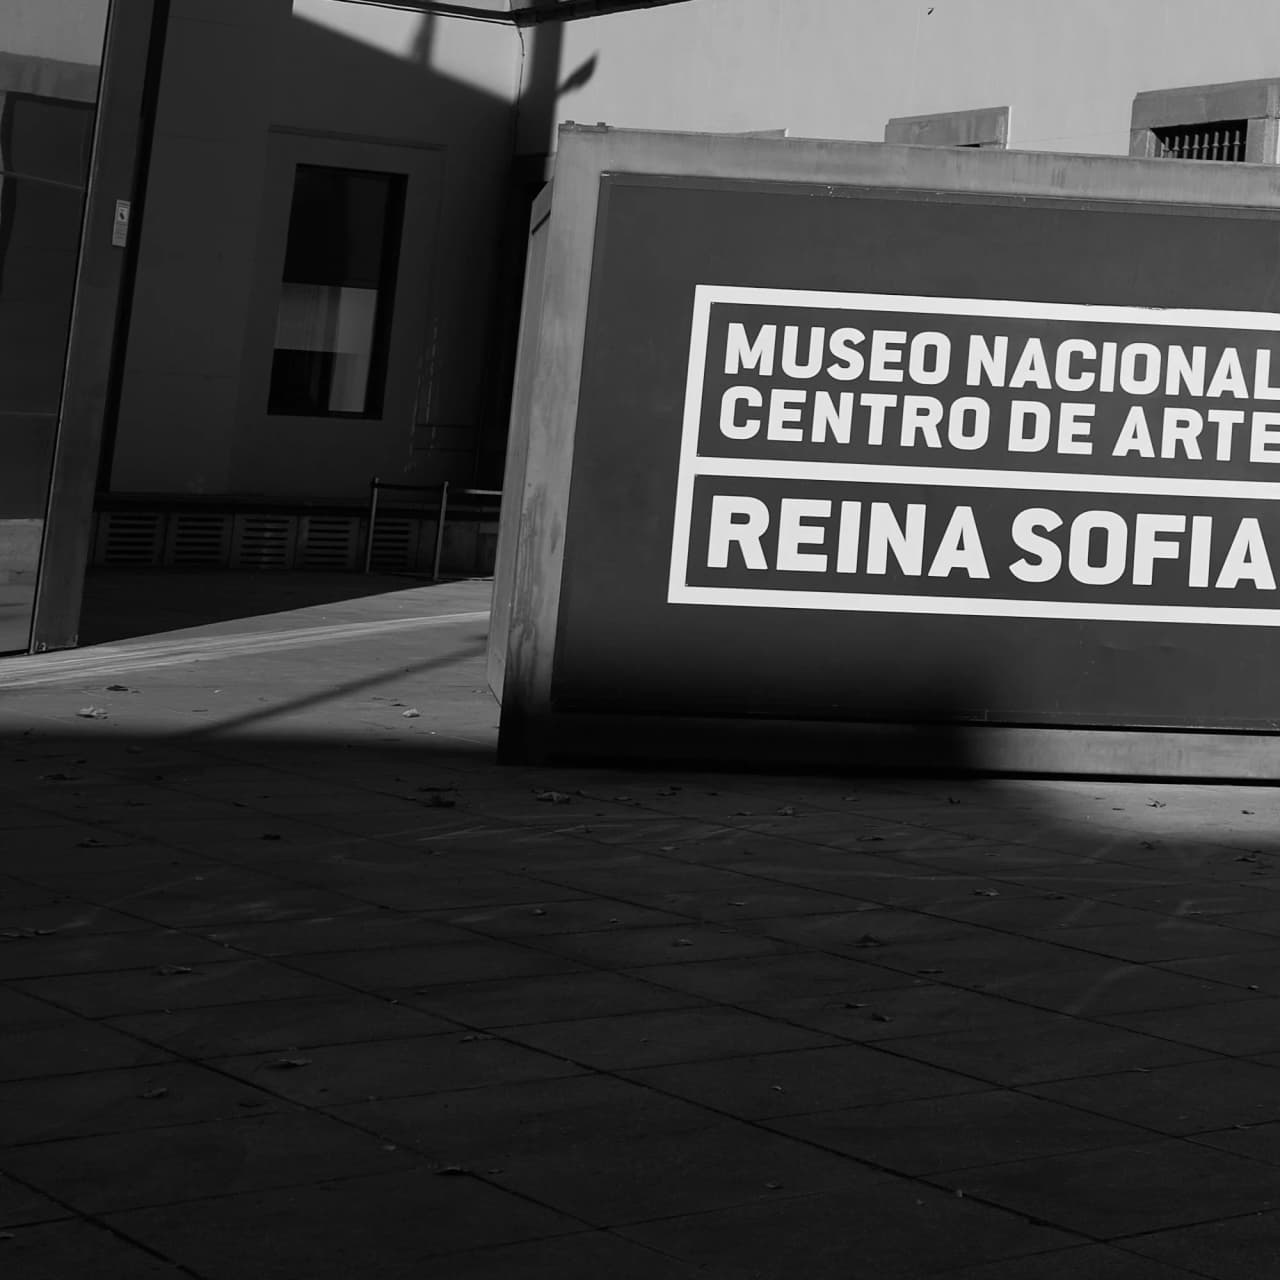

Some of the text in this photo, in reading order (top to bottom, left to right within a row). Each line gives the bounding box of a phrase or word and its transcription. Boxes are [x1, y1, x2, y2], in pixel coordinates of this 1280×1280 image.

[725, 323, 951, 384] MUSEO
[720, 386, 990, 450] CENTRO
[1008, 400, 1095, 455] DE
[708, 496, 1276, 589] REINA SOFIA
